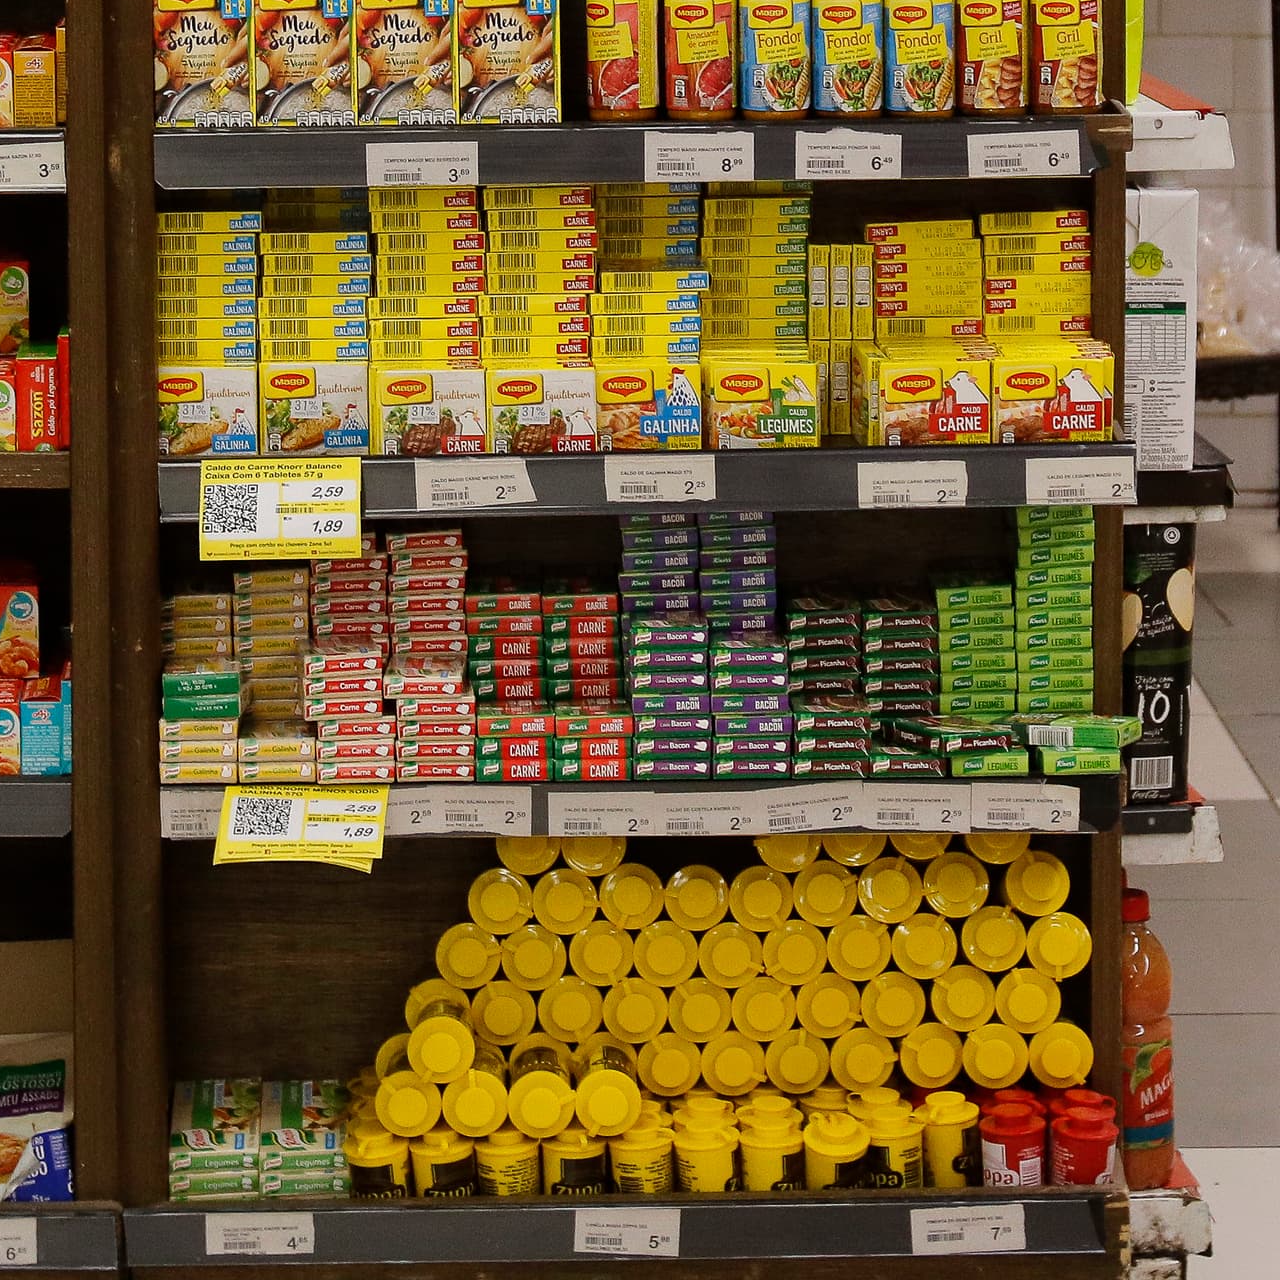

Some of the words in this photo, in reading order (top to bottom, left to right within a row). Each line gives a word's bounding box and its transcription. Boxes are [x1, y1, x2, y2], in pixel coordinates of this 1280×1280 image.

[756, 7, 783, 19] Maggi
[180, 15, 213, 33] Meu
[168, 29, 230, 53] Segredo
[757, 31, 802, 49] Fondor
[979, 31, 1003, 44] Gril
[182, 403, 207, 416] 31%
[673, 408, 693, 416] CALDO
[643, 419, 700, 434] GALINHA
[760, 418, 814, 434] LEGUMES
[937, 416, 983, 431] CARNE
[1052, 414, 1097, 429] CARNE
[215, 437, 251, 452] GALINHA
[447, 439, 483, 452] CARNE
[206, 464, 230, 472] Caldo
[233, 464, 244, 472] de
[247, 464, 273, 472] Carne
[277, 463, 302, 472] Knorr
[306, 462, 342, 471] Balance
[206, 471, 228, 480] Caixa
[231, 471, 251, 480] Com
[254, 472, 260, 480] 6
[263, 471, 300, 479] Tabletes
[303, 471, 314, 479] 57
[311, 486, 344, 499] 2,59
[310, 520, 343, 533] 1,89
[339, 724, 372, 734] Carne
[667, 761, 690, 771] Bacon
[824, 761, 851, 772] Picanha
[987, 761, 1018, 773] LEGUMES
[345, 804, 377, 812] 2,59
[343, 828, 373, 838] 1,89
